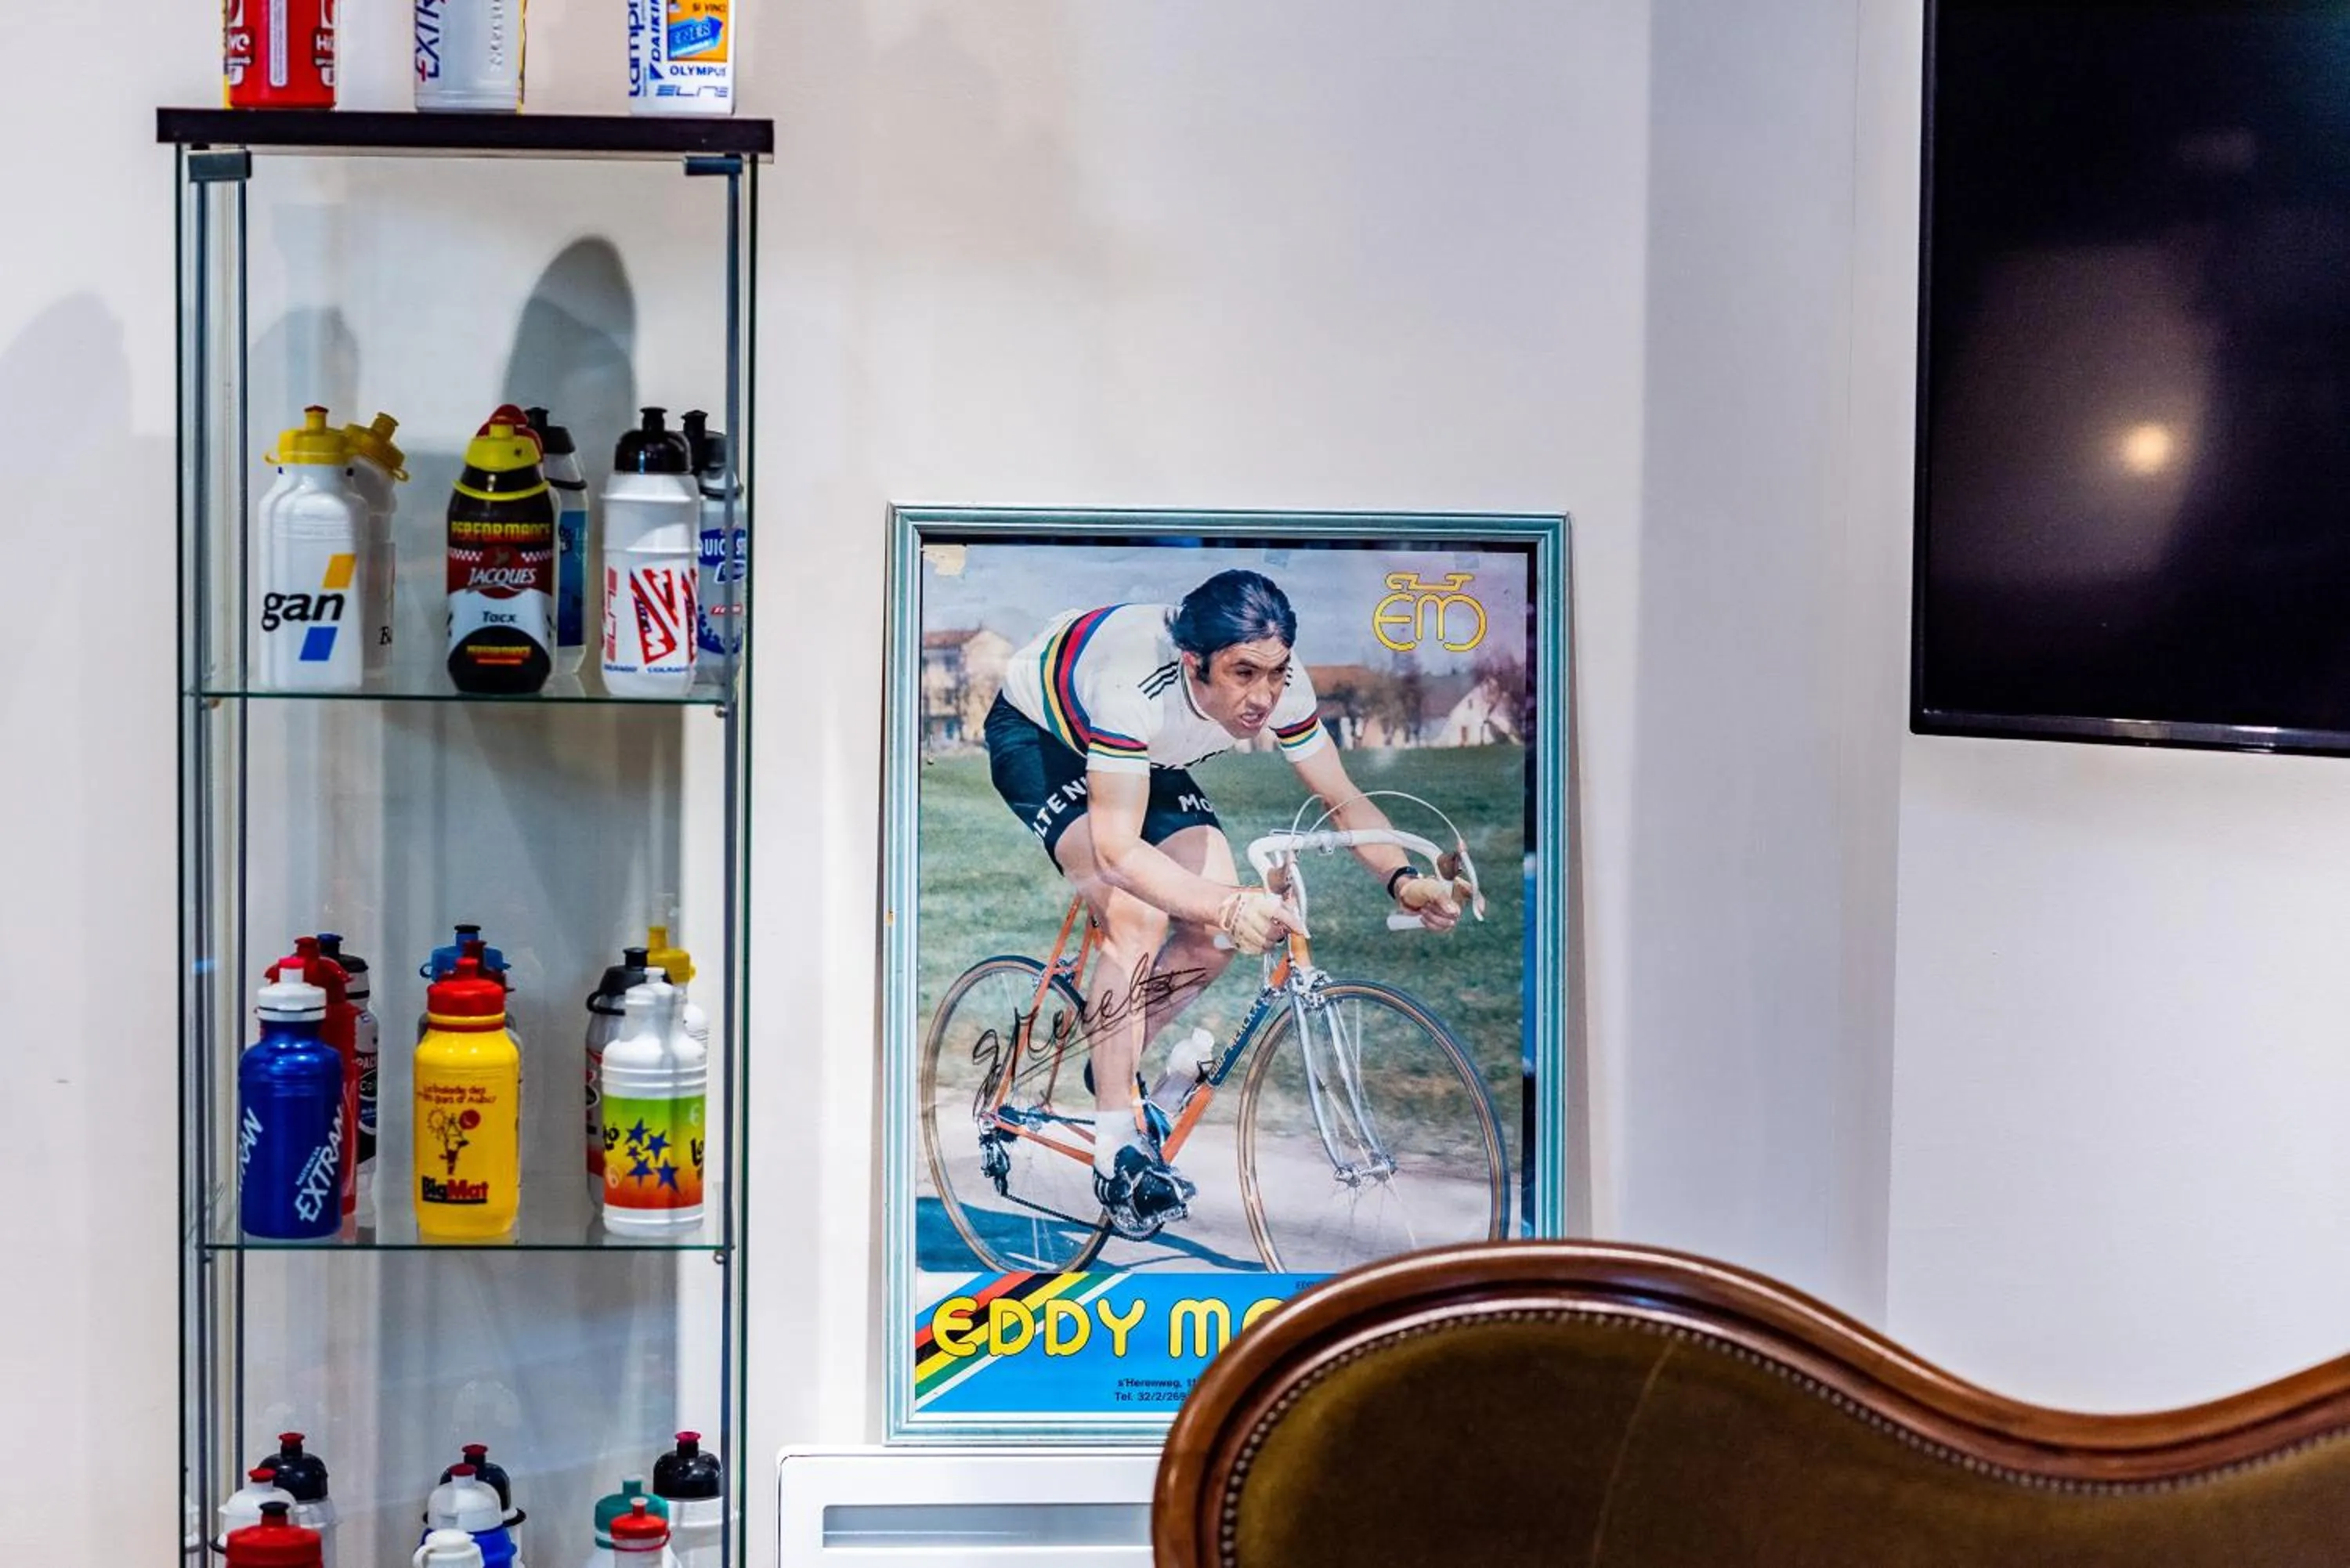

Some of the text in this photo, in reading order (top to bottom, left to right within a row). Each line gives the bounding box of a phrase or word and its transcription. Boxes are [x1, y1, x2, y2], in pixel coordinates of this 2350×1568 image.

[468, 568, 537, 587] JACQUES
[262, 592, 345, 631] gan
[483, 611, 517, 623] Tacx
[294, 1104, 343, 1223] EXTRAN
[421, 1176, 489, 1201] BigMat
[931, 1296, 1147, 1358] EDDY
[1115, 1392, 1186, 1401] Tel. 32/2/269
